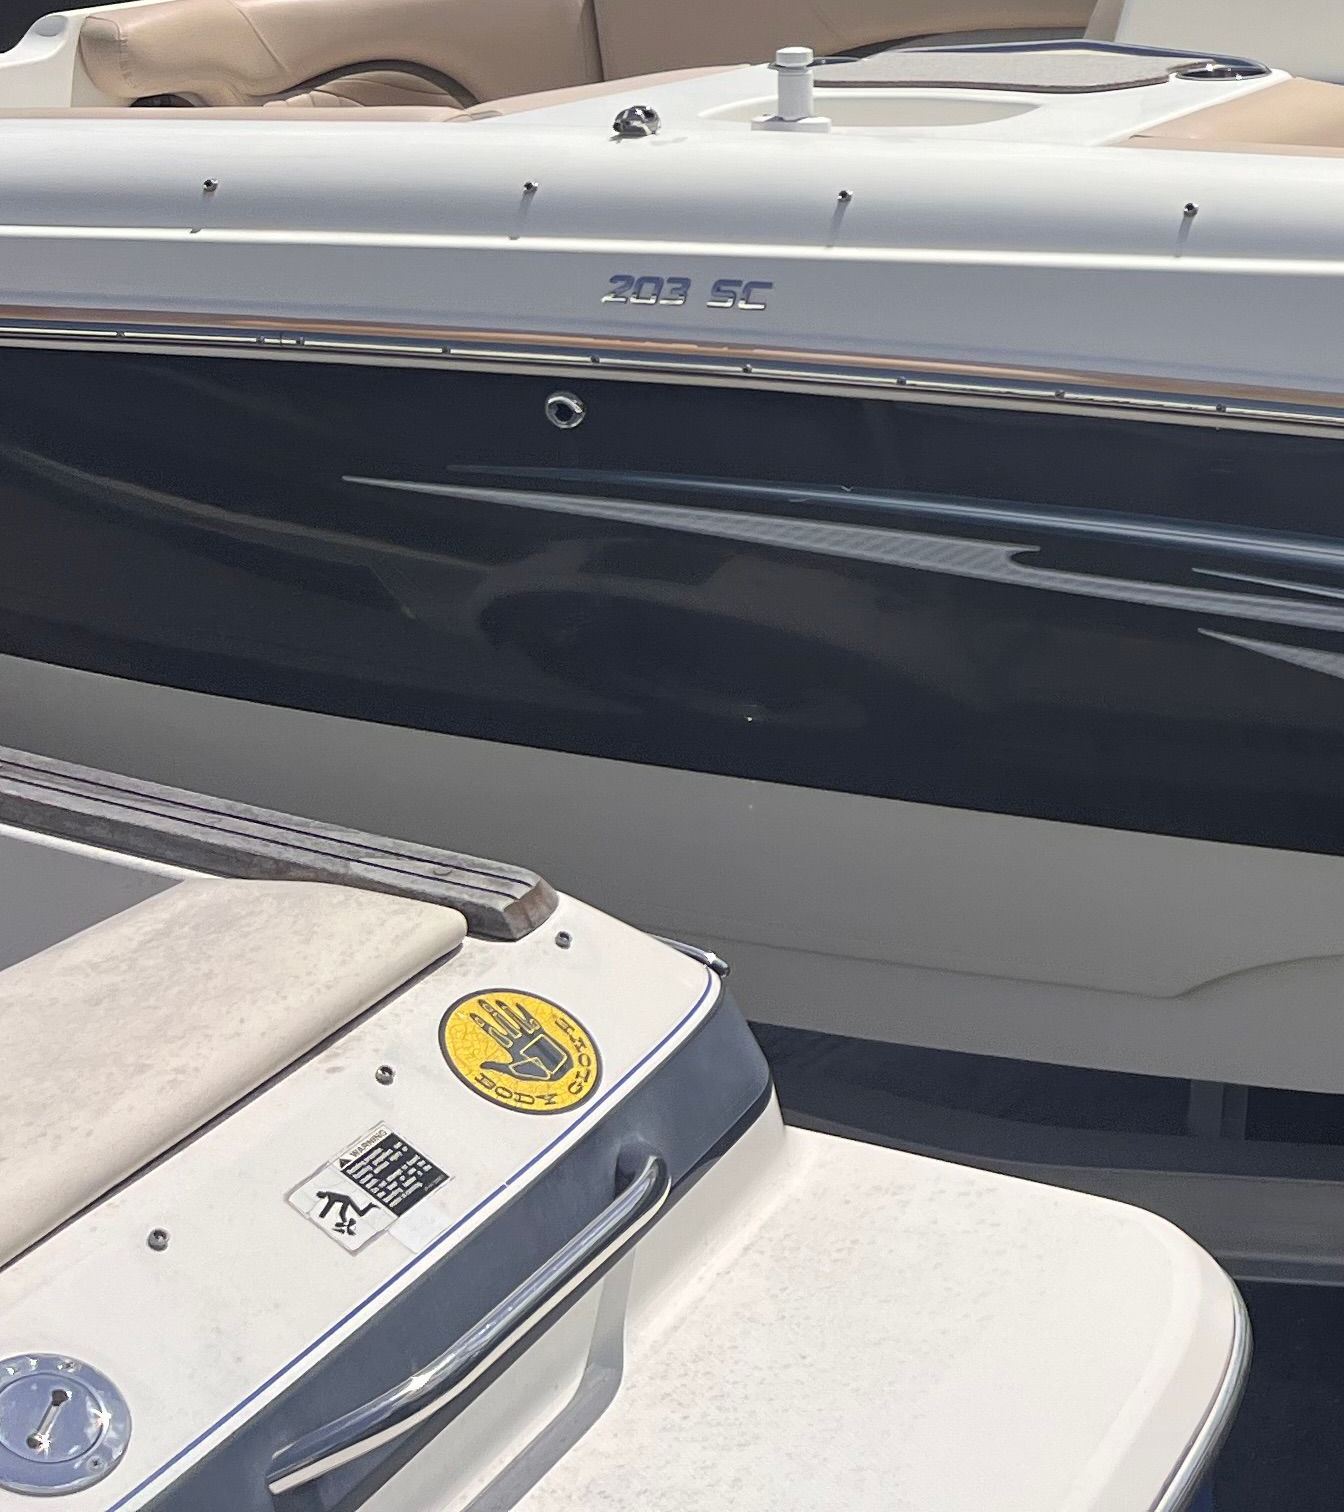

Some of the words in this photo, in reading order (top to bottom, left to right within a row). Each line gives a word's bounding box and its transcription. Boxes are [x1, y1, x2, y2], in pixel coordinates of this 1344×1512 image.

[601, 274, 691, 306] 203
[706, 279, 773, 311] SC
[474, 1073, 558, 1105] BODY
[554, 1016, 592, 1095] GLOVE
[350, 1129, 388, 1158] WARNING
